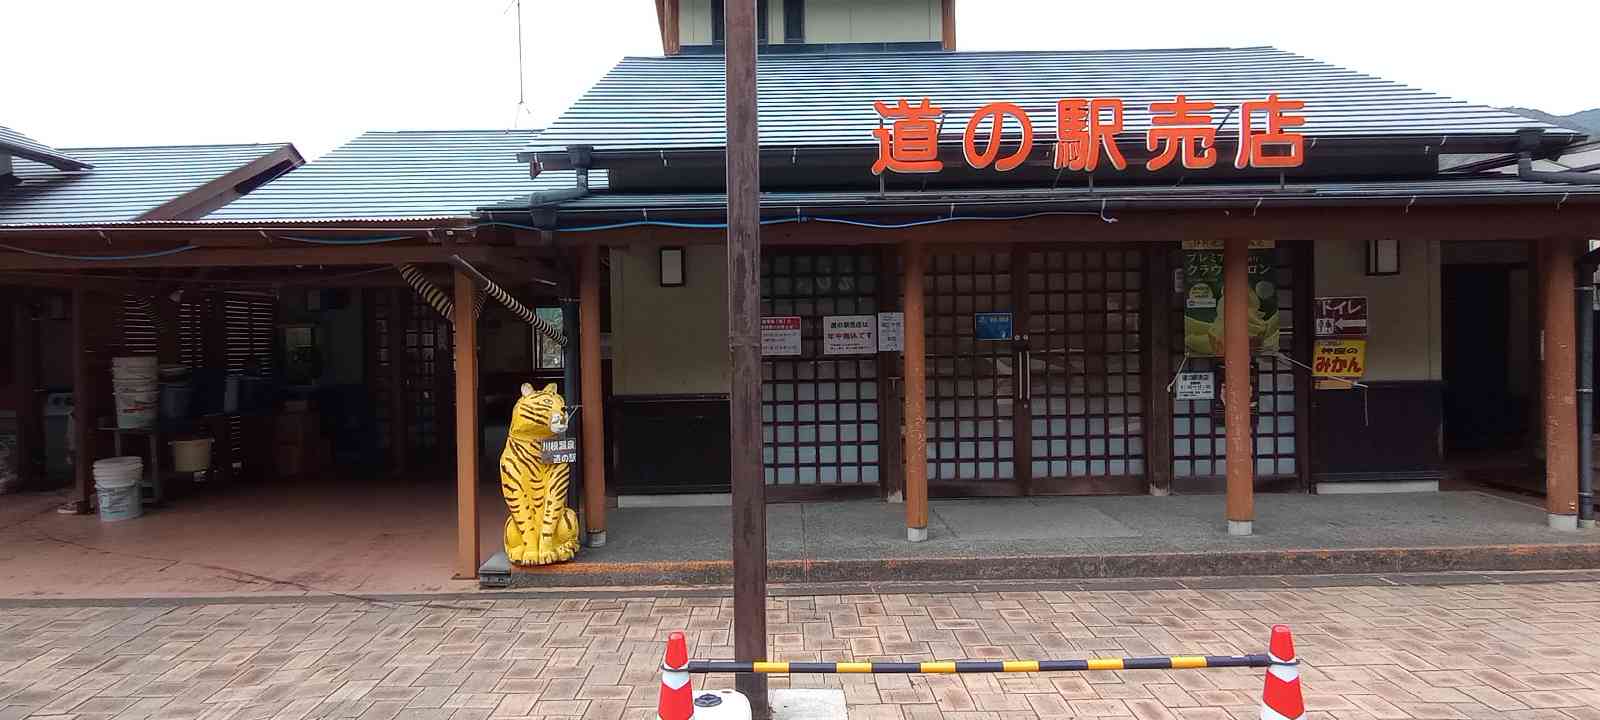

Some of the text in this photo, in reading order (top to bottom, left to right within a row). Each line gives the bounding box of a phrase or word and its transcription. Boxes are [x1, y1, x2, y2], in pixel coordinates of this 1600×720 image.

[872, 94, 1305, 174] 道の駅売店
[1187, 264, 1273, 276] クラウロン
[1320, 299, 1361, 315] トイレ
[1315, 356, 1362, 373] みかん
[542, 440, 576, 451] 川根温泉
[553, 453, 577, 464] 道の駅
